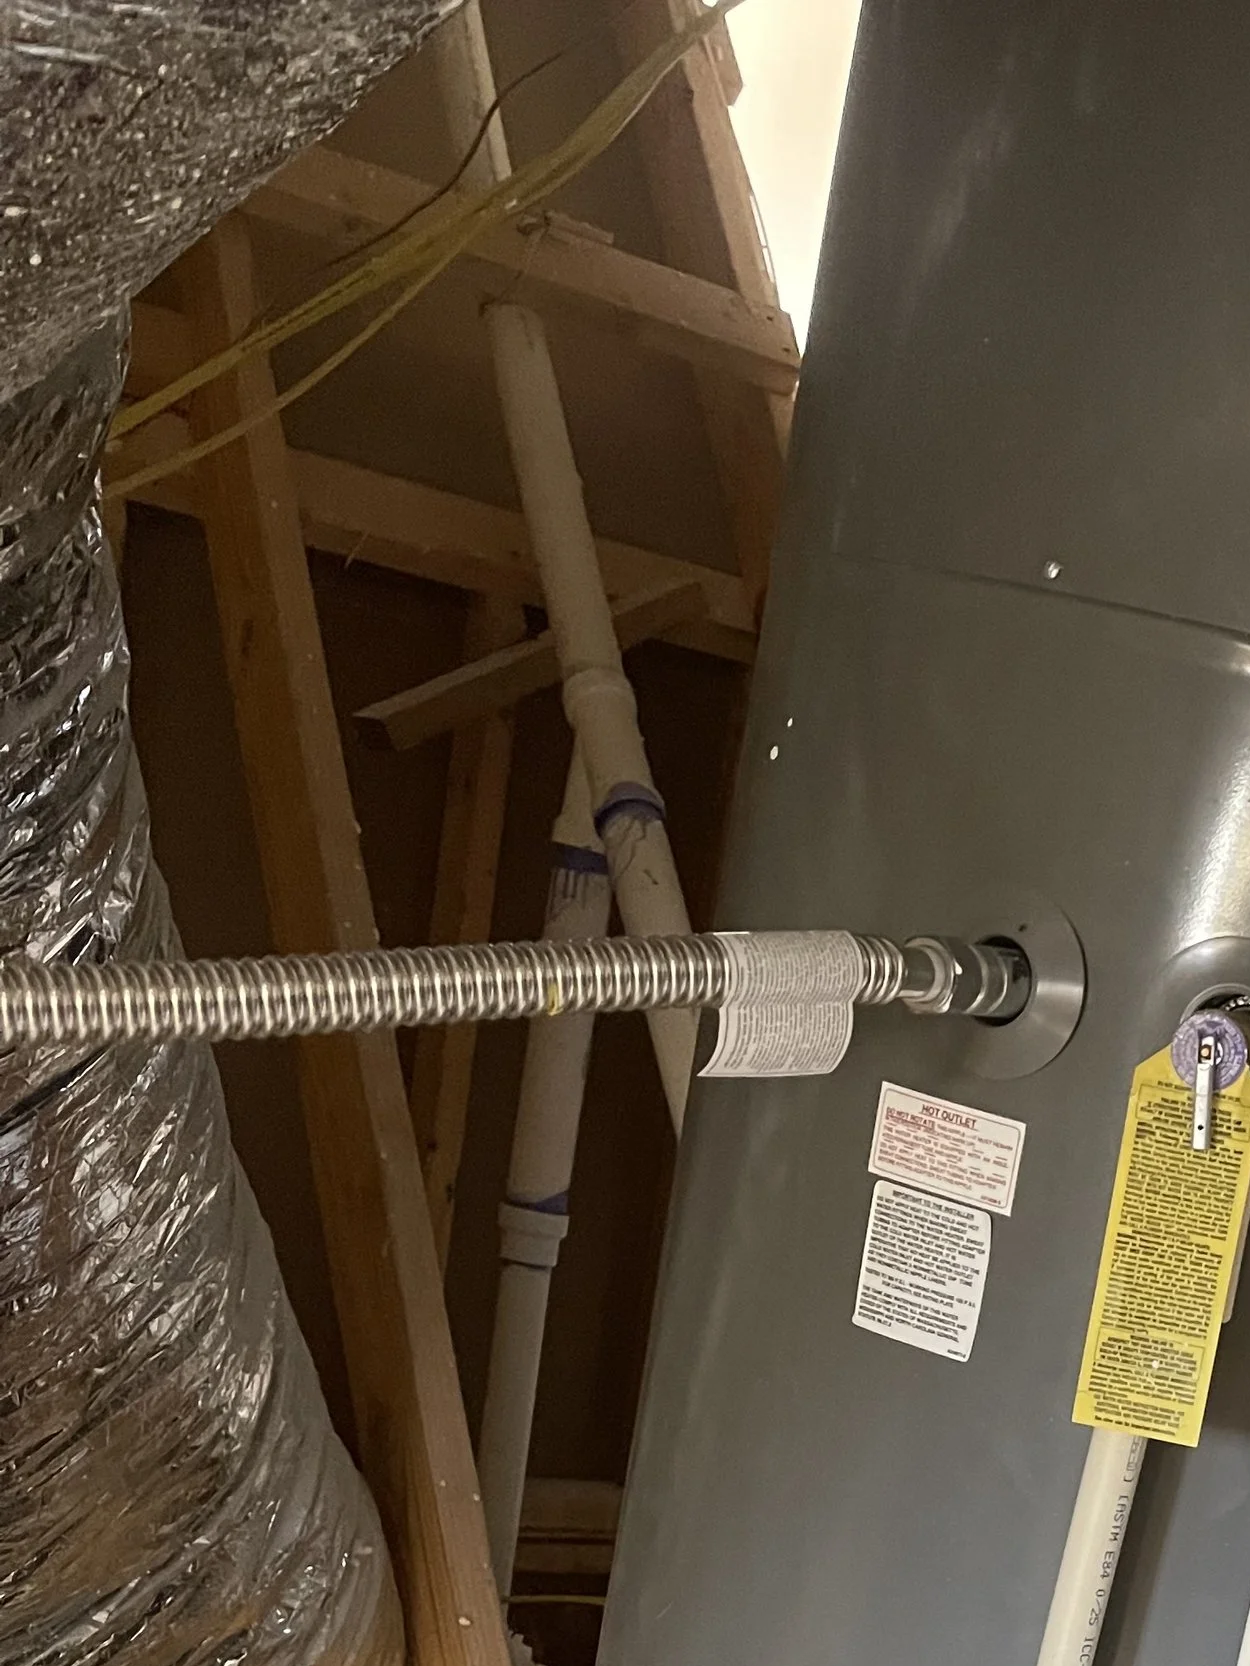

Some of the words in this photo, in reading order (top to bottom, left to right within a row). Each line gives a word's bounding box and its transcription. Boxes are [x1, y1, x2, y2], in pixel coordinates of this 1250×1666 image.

[921, 1104, 940, 1118] HOT
[941, 1110, 976, 1128] OUTLET
[1100, 1551, 1116, 1579] E84
